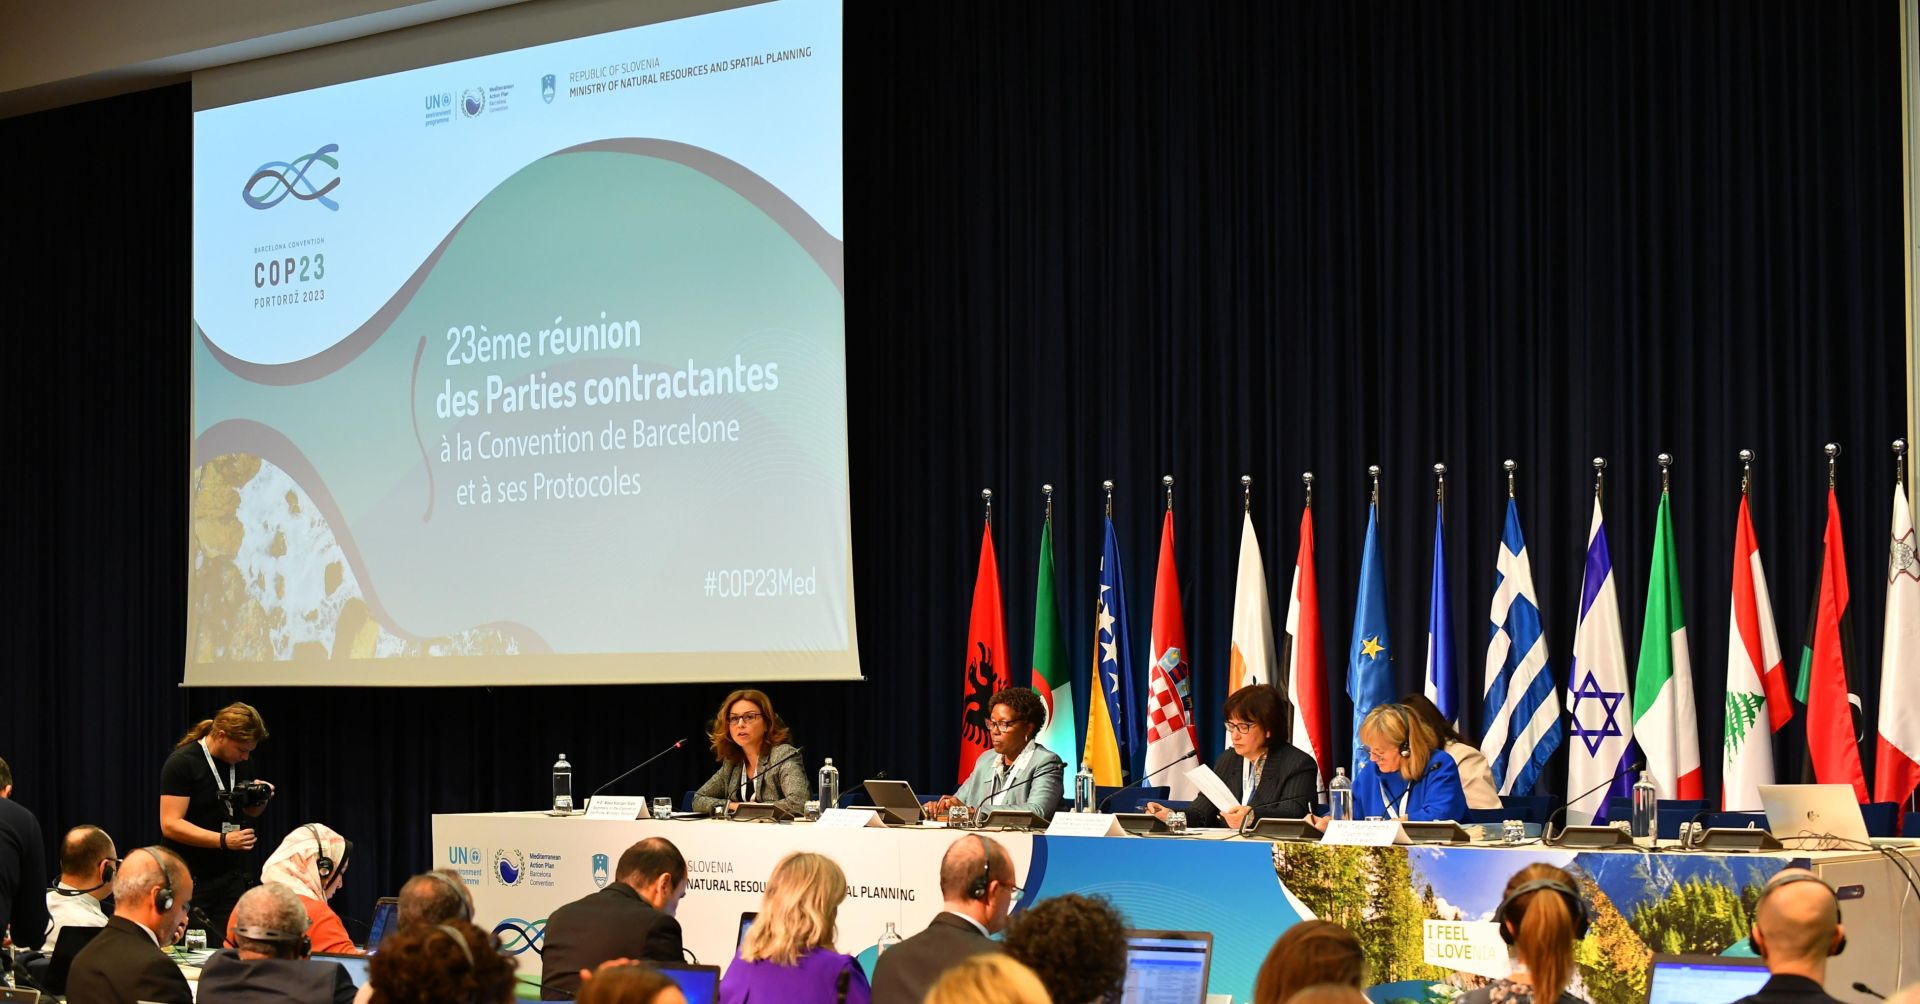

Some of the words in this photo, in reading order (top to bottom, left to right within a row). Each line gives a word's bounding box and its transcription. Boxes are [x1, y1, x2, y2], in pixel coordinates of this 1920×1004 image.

[569, 66, 607, 83] REPUBLIC
[608, 64, 620, 76] OF
[621, 57, 660, 74] SLOVENIA
[569, 82, 607, 98] MINISTRY
[608, 80, 619, 91] OF
[620, 73, 658, 89] NATURAL
[659, 64, 708, 82] RESOURCES
[710, 60, 729, 74] AND
[730, 54, 764, 70] SPATIAL
[766, 46, 812, 64] PLANNING
[425, 94, 440, 109] UN
[254, 243, 286, 253] BARCELONA
[288, 238, 324, 248] CONVENTION
[254, 253, 324, 288] COP23
[254, 289, 299, 309] PORTOROŽ
[303, 289, 324, 302] 2023
[446, 325, 531, 366] 23ème
[538, 311, 641, 356] réunion
[436, 379, 479, 418] des
[486, 372, 576, 413] Parties
[583, 354, 779, 406] contractantes
[440, 434, 450, 463] à
[456, 432, 472, 462] la
[478, 425, 594, 459] Convention
[600, 419, 626, 451] de
[633, 413, 740, 449] Barcelone
[456, 478, 476, 505] et
[481, 475, 491, 503] à
[497, 480, 528, 503] ses
[533, 465, 641, 500] Protocoles
[704, 566, 816, 598] #COP23Med
[448, 846, 468, 865] UN
[529, 853, 561, 861] Mediterranean
[458, 868, 482, 876] ronment
[529, 870, 552, 878] Barcelona
[687, 860, 734, 874] SLOVENIA
[529, 878, 555, 887] Convention
[687, 878, 732, 892] NATURAL
[733, 880, 766, 893] RESOU
[860, 886, 915, 902] PLANNING
[1428, 924, 1433, 939] I
[1437, 925, 1469, 941] FEEL
